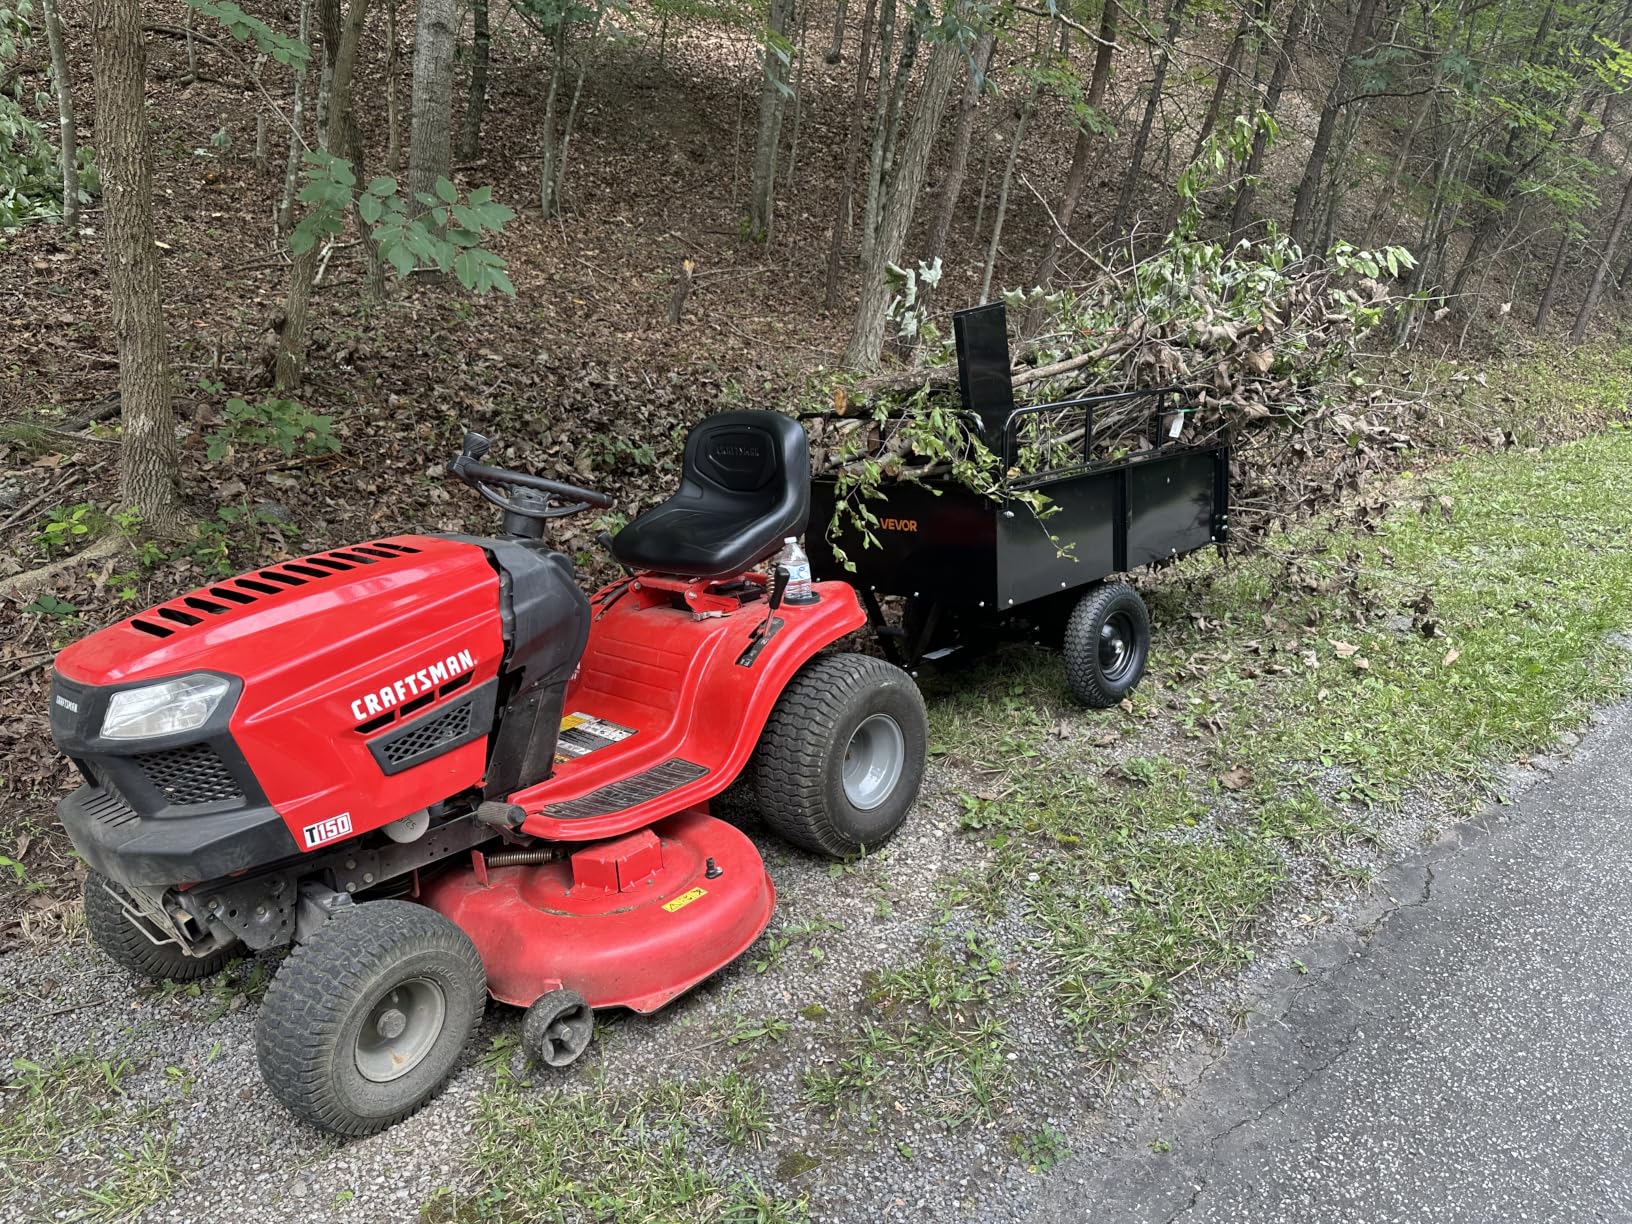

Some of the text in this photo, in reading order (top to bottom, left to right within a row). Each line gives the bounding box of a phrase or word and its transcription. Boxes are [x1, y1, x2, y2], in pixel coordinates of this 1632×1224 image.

[880, 518, 918, 532] VEVOR
[351, 648, 474, 720] CRAFTSMAN
[305, 814, 351, 844] T150
